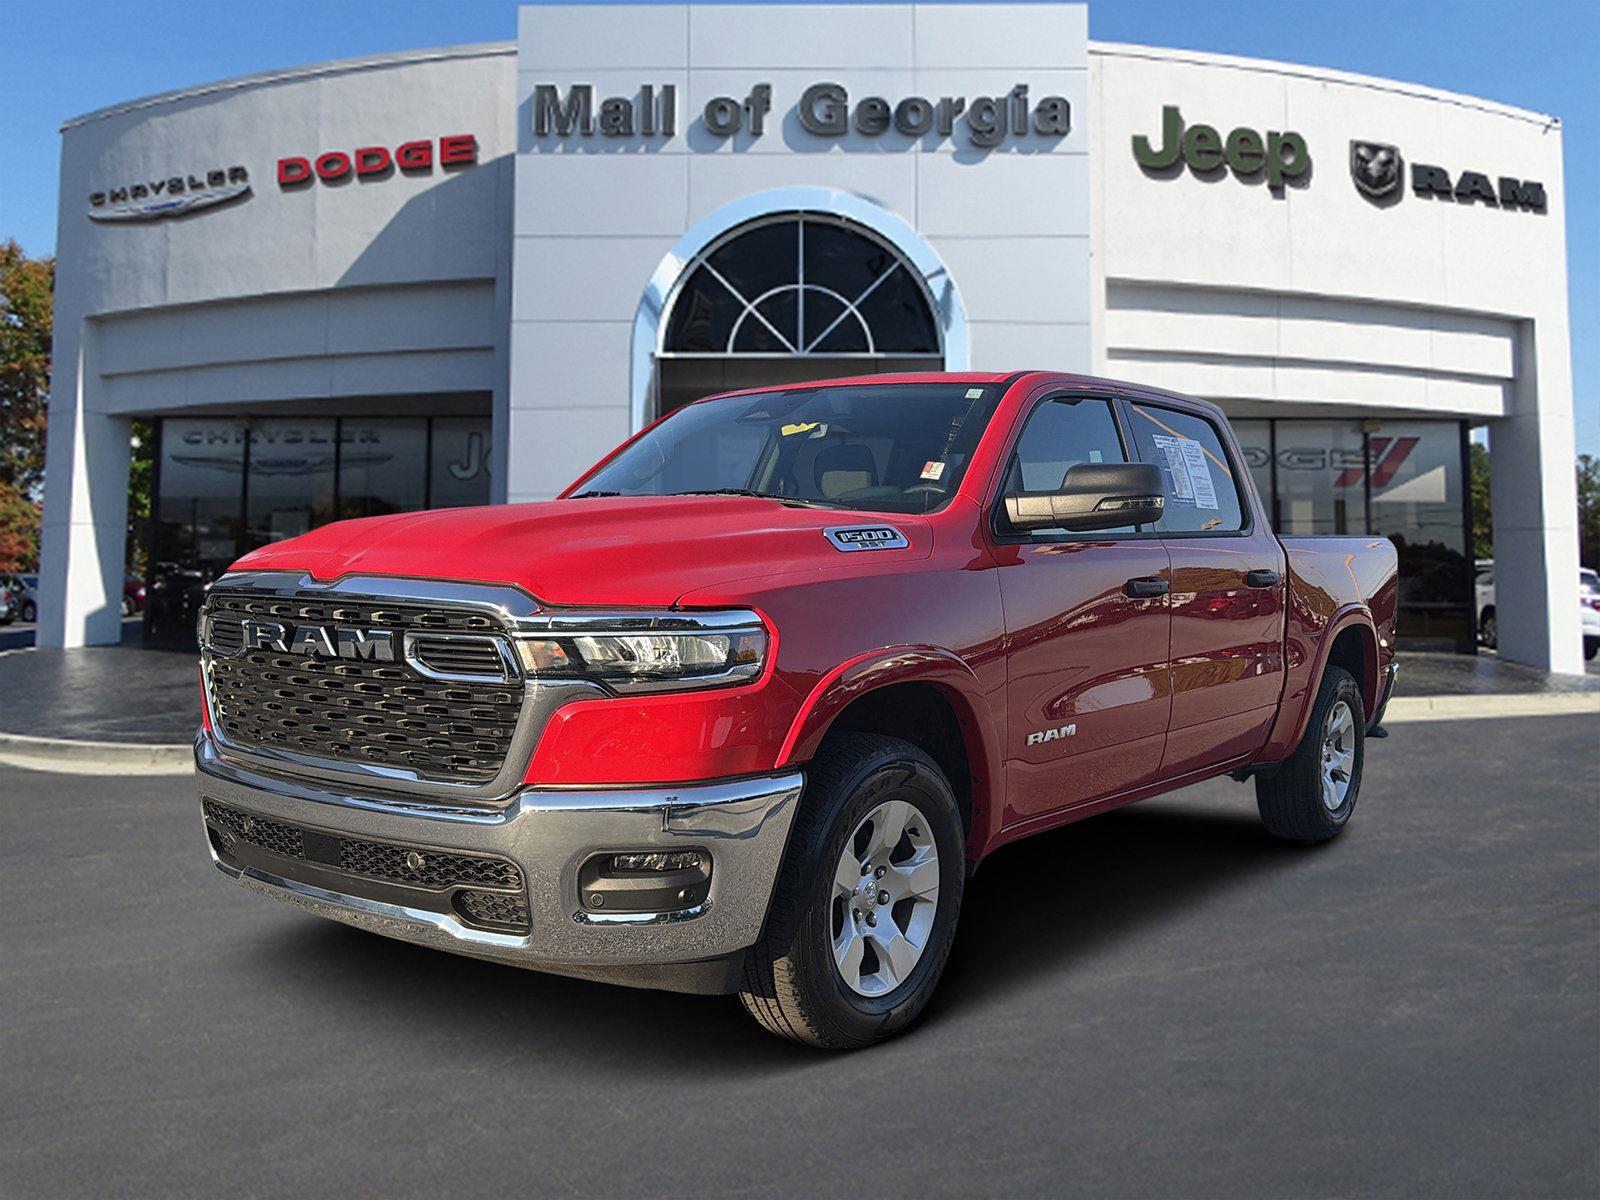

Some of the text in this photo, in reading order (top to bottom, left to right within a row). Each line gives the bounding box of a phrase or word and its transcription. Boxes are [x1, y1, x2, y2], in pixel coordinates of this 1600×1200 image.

[533, 82, 1071, 148] Mall of Georgia
[277, 134, 478, 184] DODGE
[1132, 104, 1309, 188] Jeep
[89, 165, 249, 207] CHRYSLER
[1410, 162, 1545, 211] RAM
[838, 530, 893, 543] 1500
[241, 619, 395, 662] RAM
[1025, 723, 1077, 747] RAM
